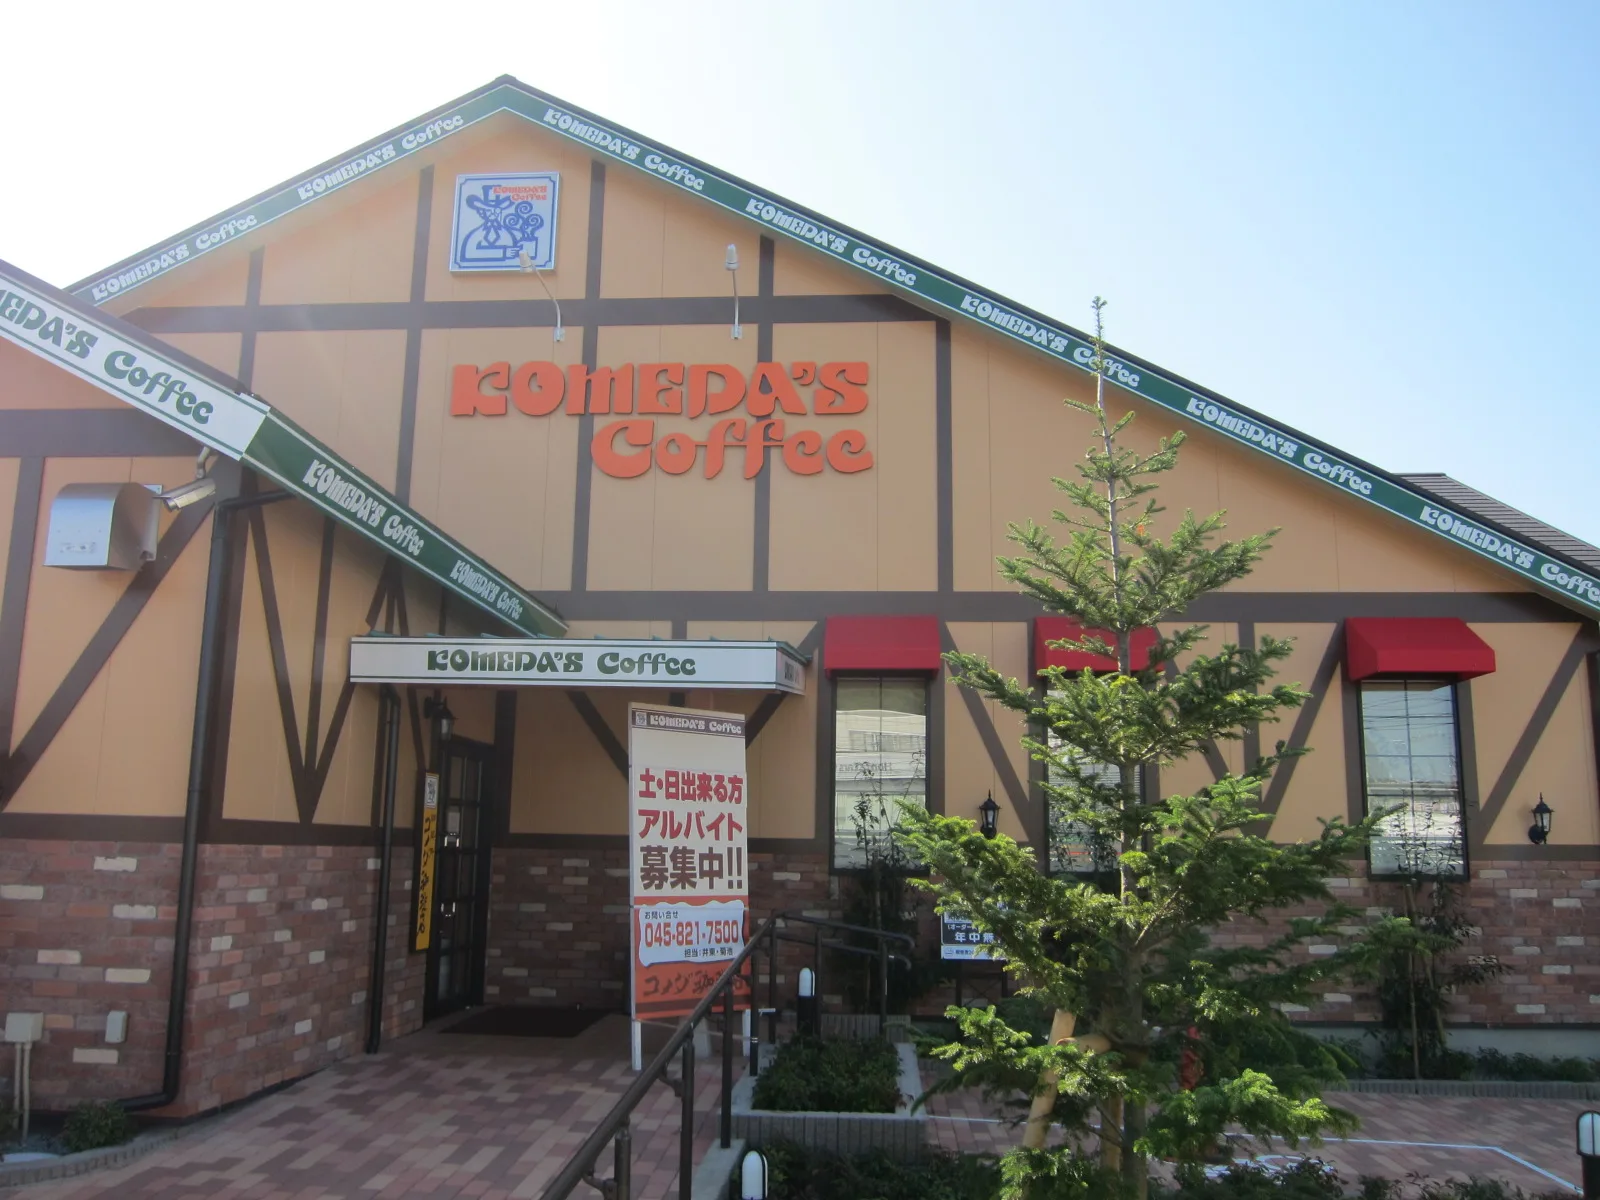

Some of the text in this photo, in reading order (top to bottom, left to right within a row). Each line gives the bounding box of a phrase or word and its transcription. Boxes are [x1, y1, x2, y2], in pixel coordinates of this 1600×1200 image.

[297, 115, 463, 200] KOMEDA'S Coffee
[543, 109, 705, 191] KOMEDA'S Coffee
[92, 214, 257, 301] KOMEDA'S Coffee
[745, 199, 916, 286] KOMEDA'S Coffee
[960, 294, 1069, 352] KOMEDA'S
[0, 289, 214, 424] EDA'S Coffee
[449, 361, 869, 419] KOMEDA'S
[590, 418, 874, 479] Coffee
[1185, 397, 1372, 496] KOMEDA'S Coffee
[302, 459, 425, 556] KOMEDA'S Coffee
[1420, 505, 1600, 602] KOMEDA'S Coffe
[450, 559, 523, 620] KOMEDA'S Coffee
[427, 649, 696, 675] KOMEDA'S Coffee
[650, 714, 742, 734] KOMEDA'S Coffee
[639, 768, 743, 804] 土・日出来る方
[638, 809, 743, 841] アルバイト
[955, 932, 996, 942] 年中無
